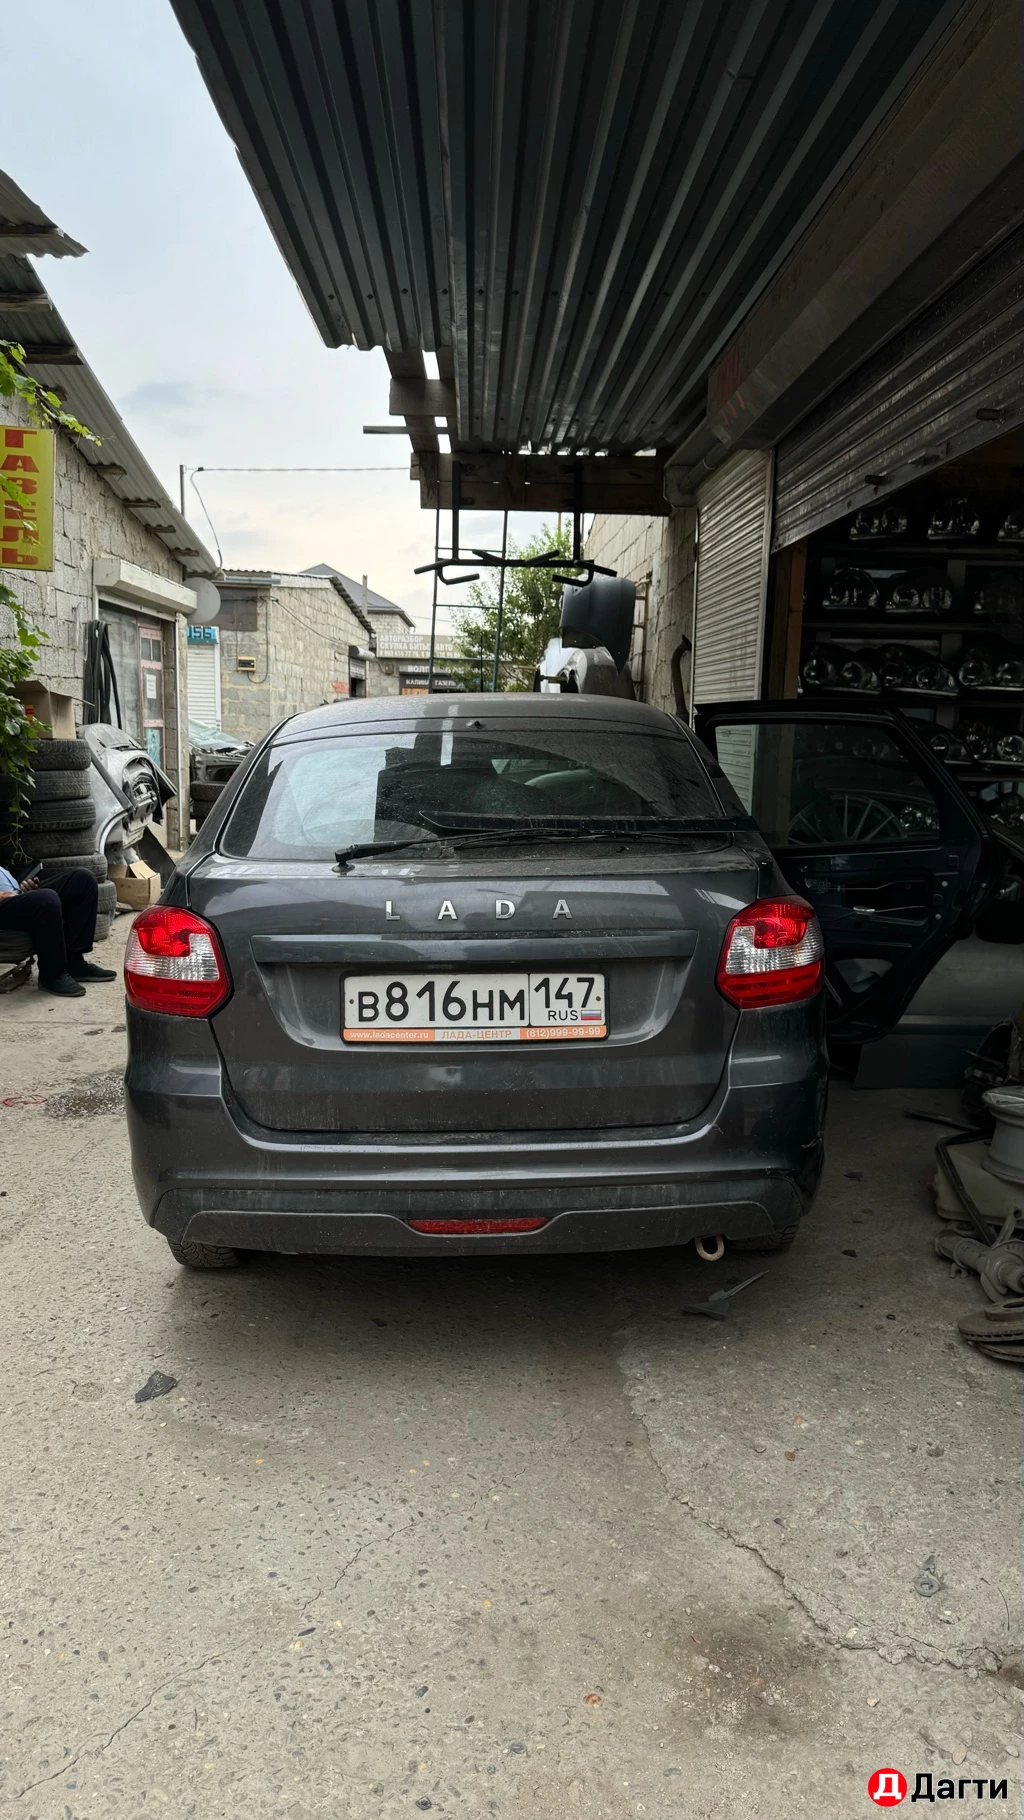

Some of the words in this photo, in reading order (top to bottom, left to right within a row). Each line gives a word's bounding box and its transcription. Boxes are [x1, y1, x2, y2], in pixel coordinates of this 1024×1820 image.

[0, 428, 40, 566] ГАЗЕЛЬ
[436, 643, 453, 651] АВТО
[385, 900, 572, 920] LADA
[358, 981, 525, 1022] В816НМ
[534, 977, 595, 1008] 147
[548, 1010, 578, 1021] RUS
[350, 1031, 429, 1039] www.ladacenter.ru
[441, 1030, 512, 1040] ЛАДА-ЦЕНТР
[526, 1027, 601, 1038] (812)999-99-99
